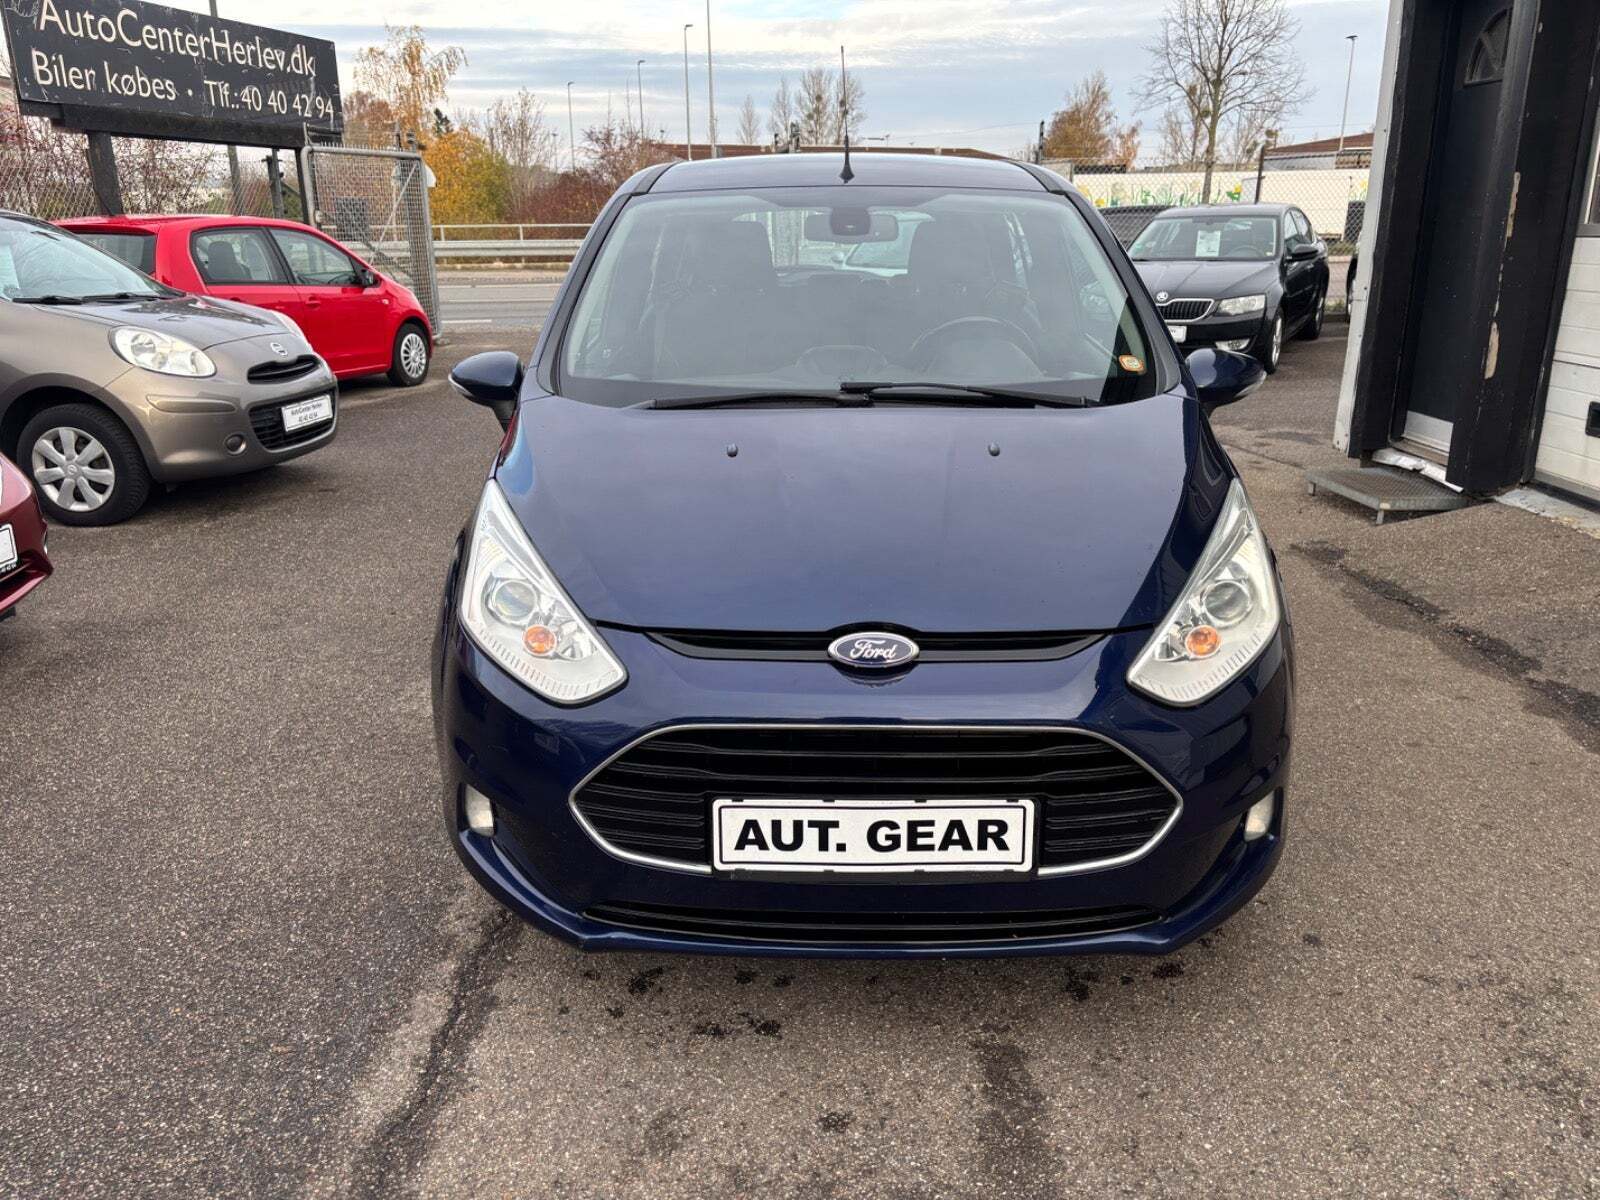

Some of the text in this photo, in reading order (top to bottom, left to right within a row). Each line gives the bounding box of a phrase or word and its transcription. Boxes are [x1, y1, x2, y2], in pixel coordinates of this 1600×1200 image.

[40, 0, 316, 77] AutoCenterHerlev.dk
[31, 48, 96, 91] Biler
[103, 60, 176, 101] købes
[268, 90, 288, 115] 40
[292, 93, 313, 118] 42
[315, 95, 334, 120] 94
[849, 639, 898, 660] Ford
[734, 818, 1010, 852] AUT. GEAR
